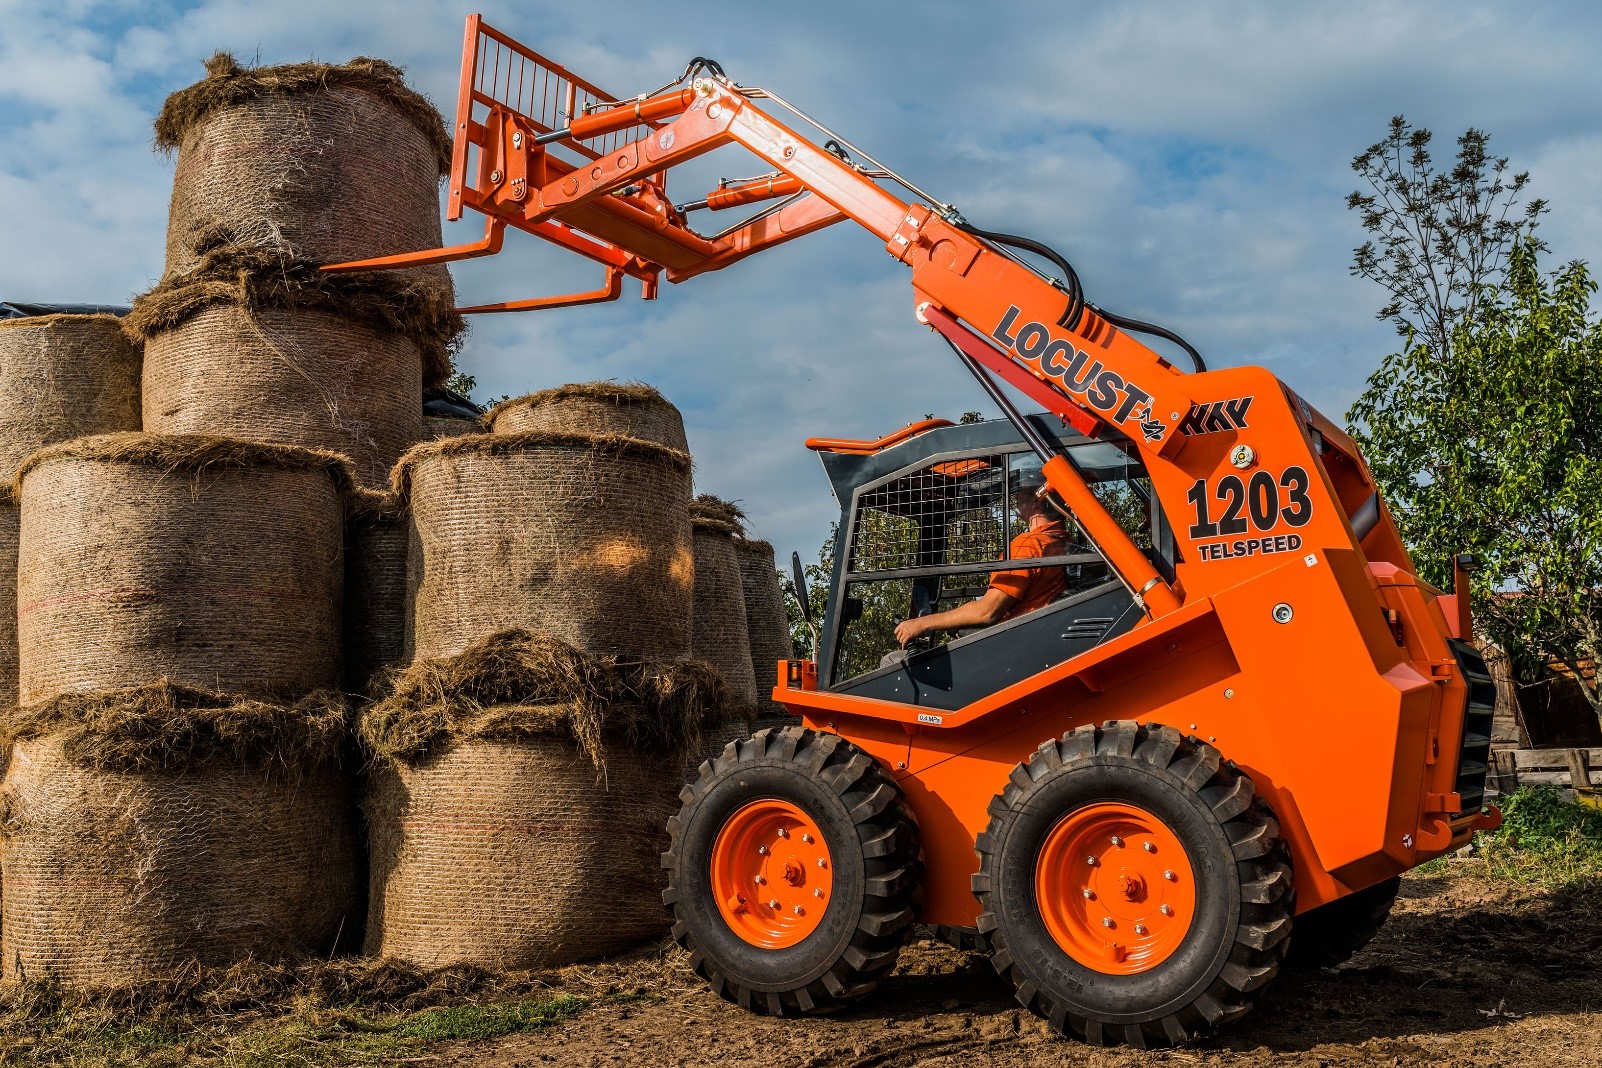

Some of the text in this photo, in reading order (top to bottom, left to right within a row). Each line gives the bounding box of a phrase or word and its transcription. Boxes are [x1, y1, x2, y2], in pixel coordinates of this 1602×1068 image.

[992, 304, 1151, 425] LOCUST
[1187, 465, 1312, 541] 1203
[1197, 534, 1303, 562] TELSPEED
